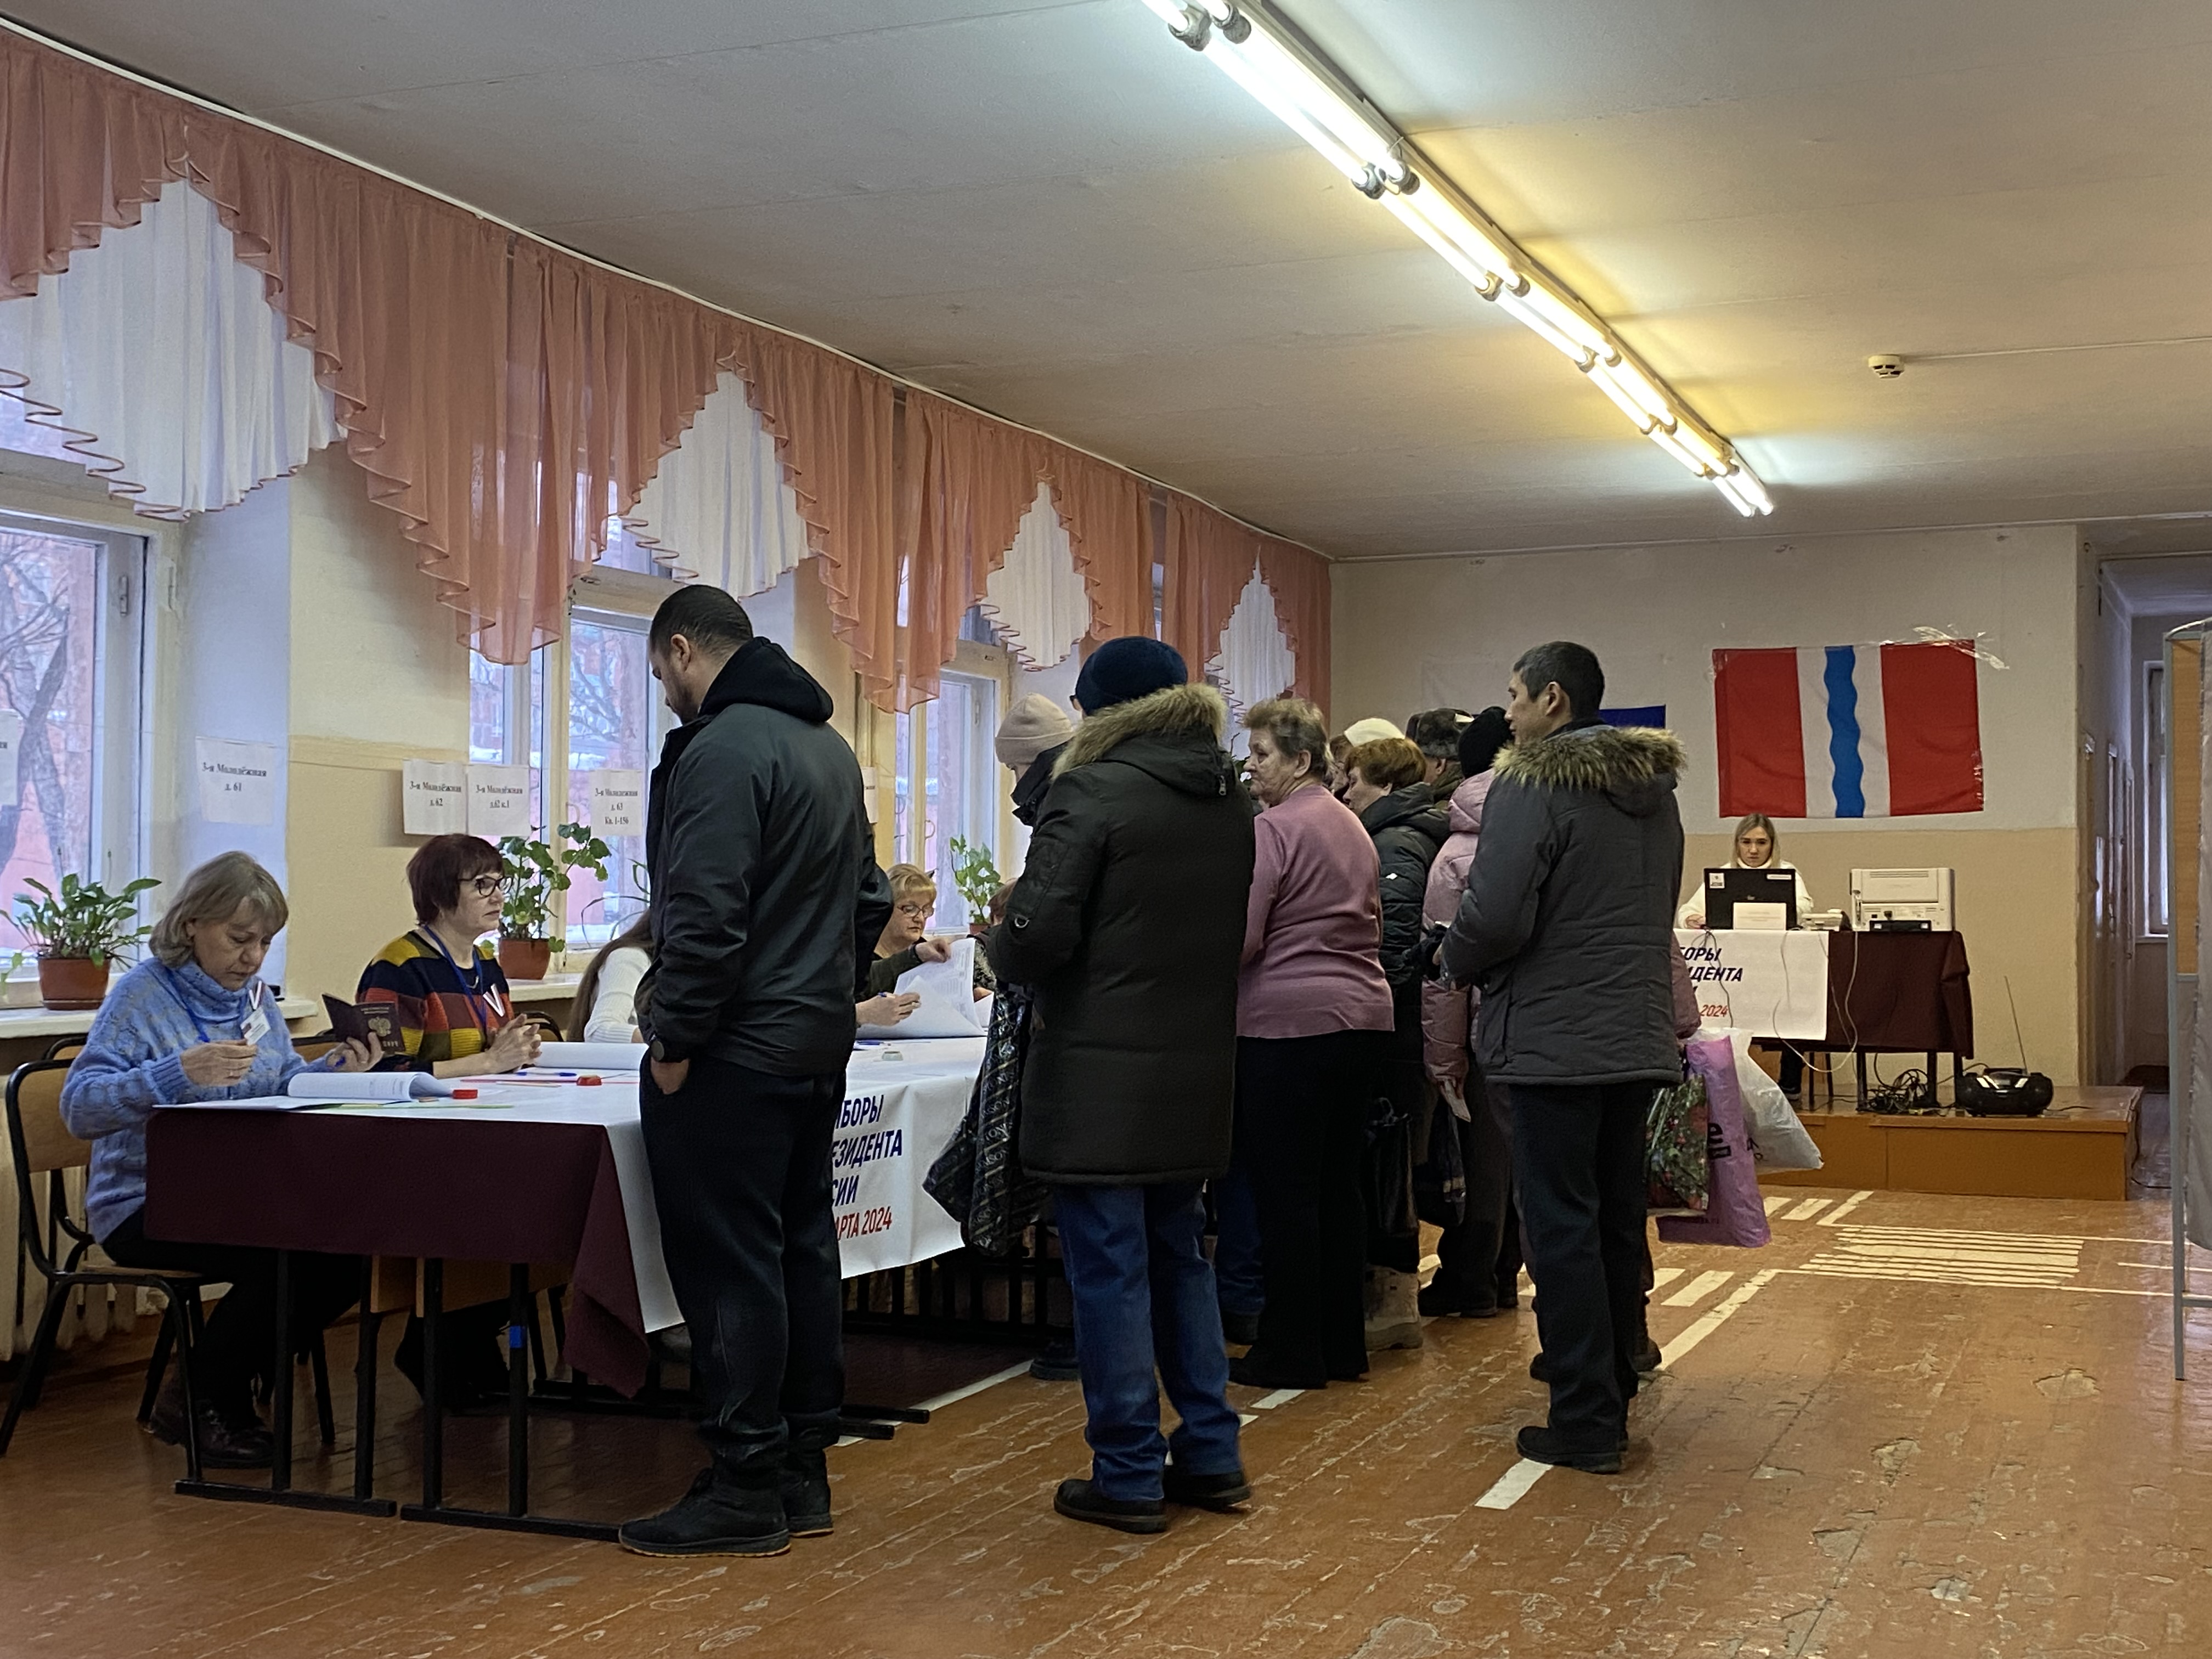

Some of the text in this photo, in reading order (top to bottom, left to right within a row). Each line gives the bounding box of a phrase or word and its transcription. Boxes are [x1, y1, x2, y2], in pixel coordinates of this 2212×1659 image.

[233, 782, 242, 791] 61
[1680, 947, 1722, 961] ОРЫ
[1689, 966, 1743, 982] ДЕНТА
[1701, 1005, 1728, 1017] 2024
[836, 1094, 884, 1129] БОРЫ
[831, 1129, 902, 1169] ЕЗИДЕНТА
[836, 1206, 893, 1241] РТА 2024
